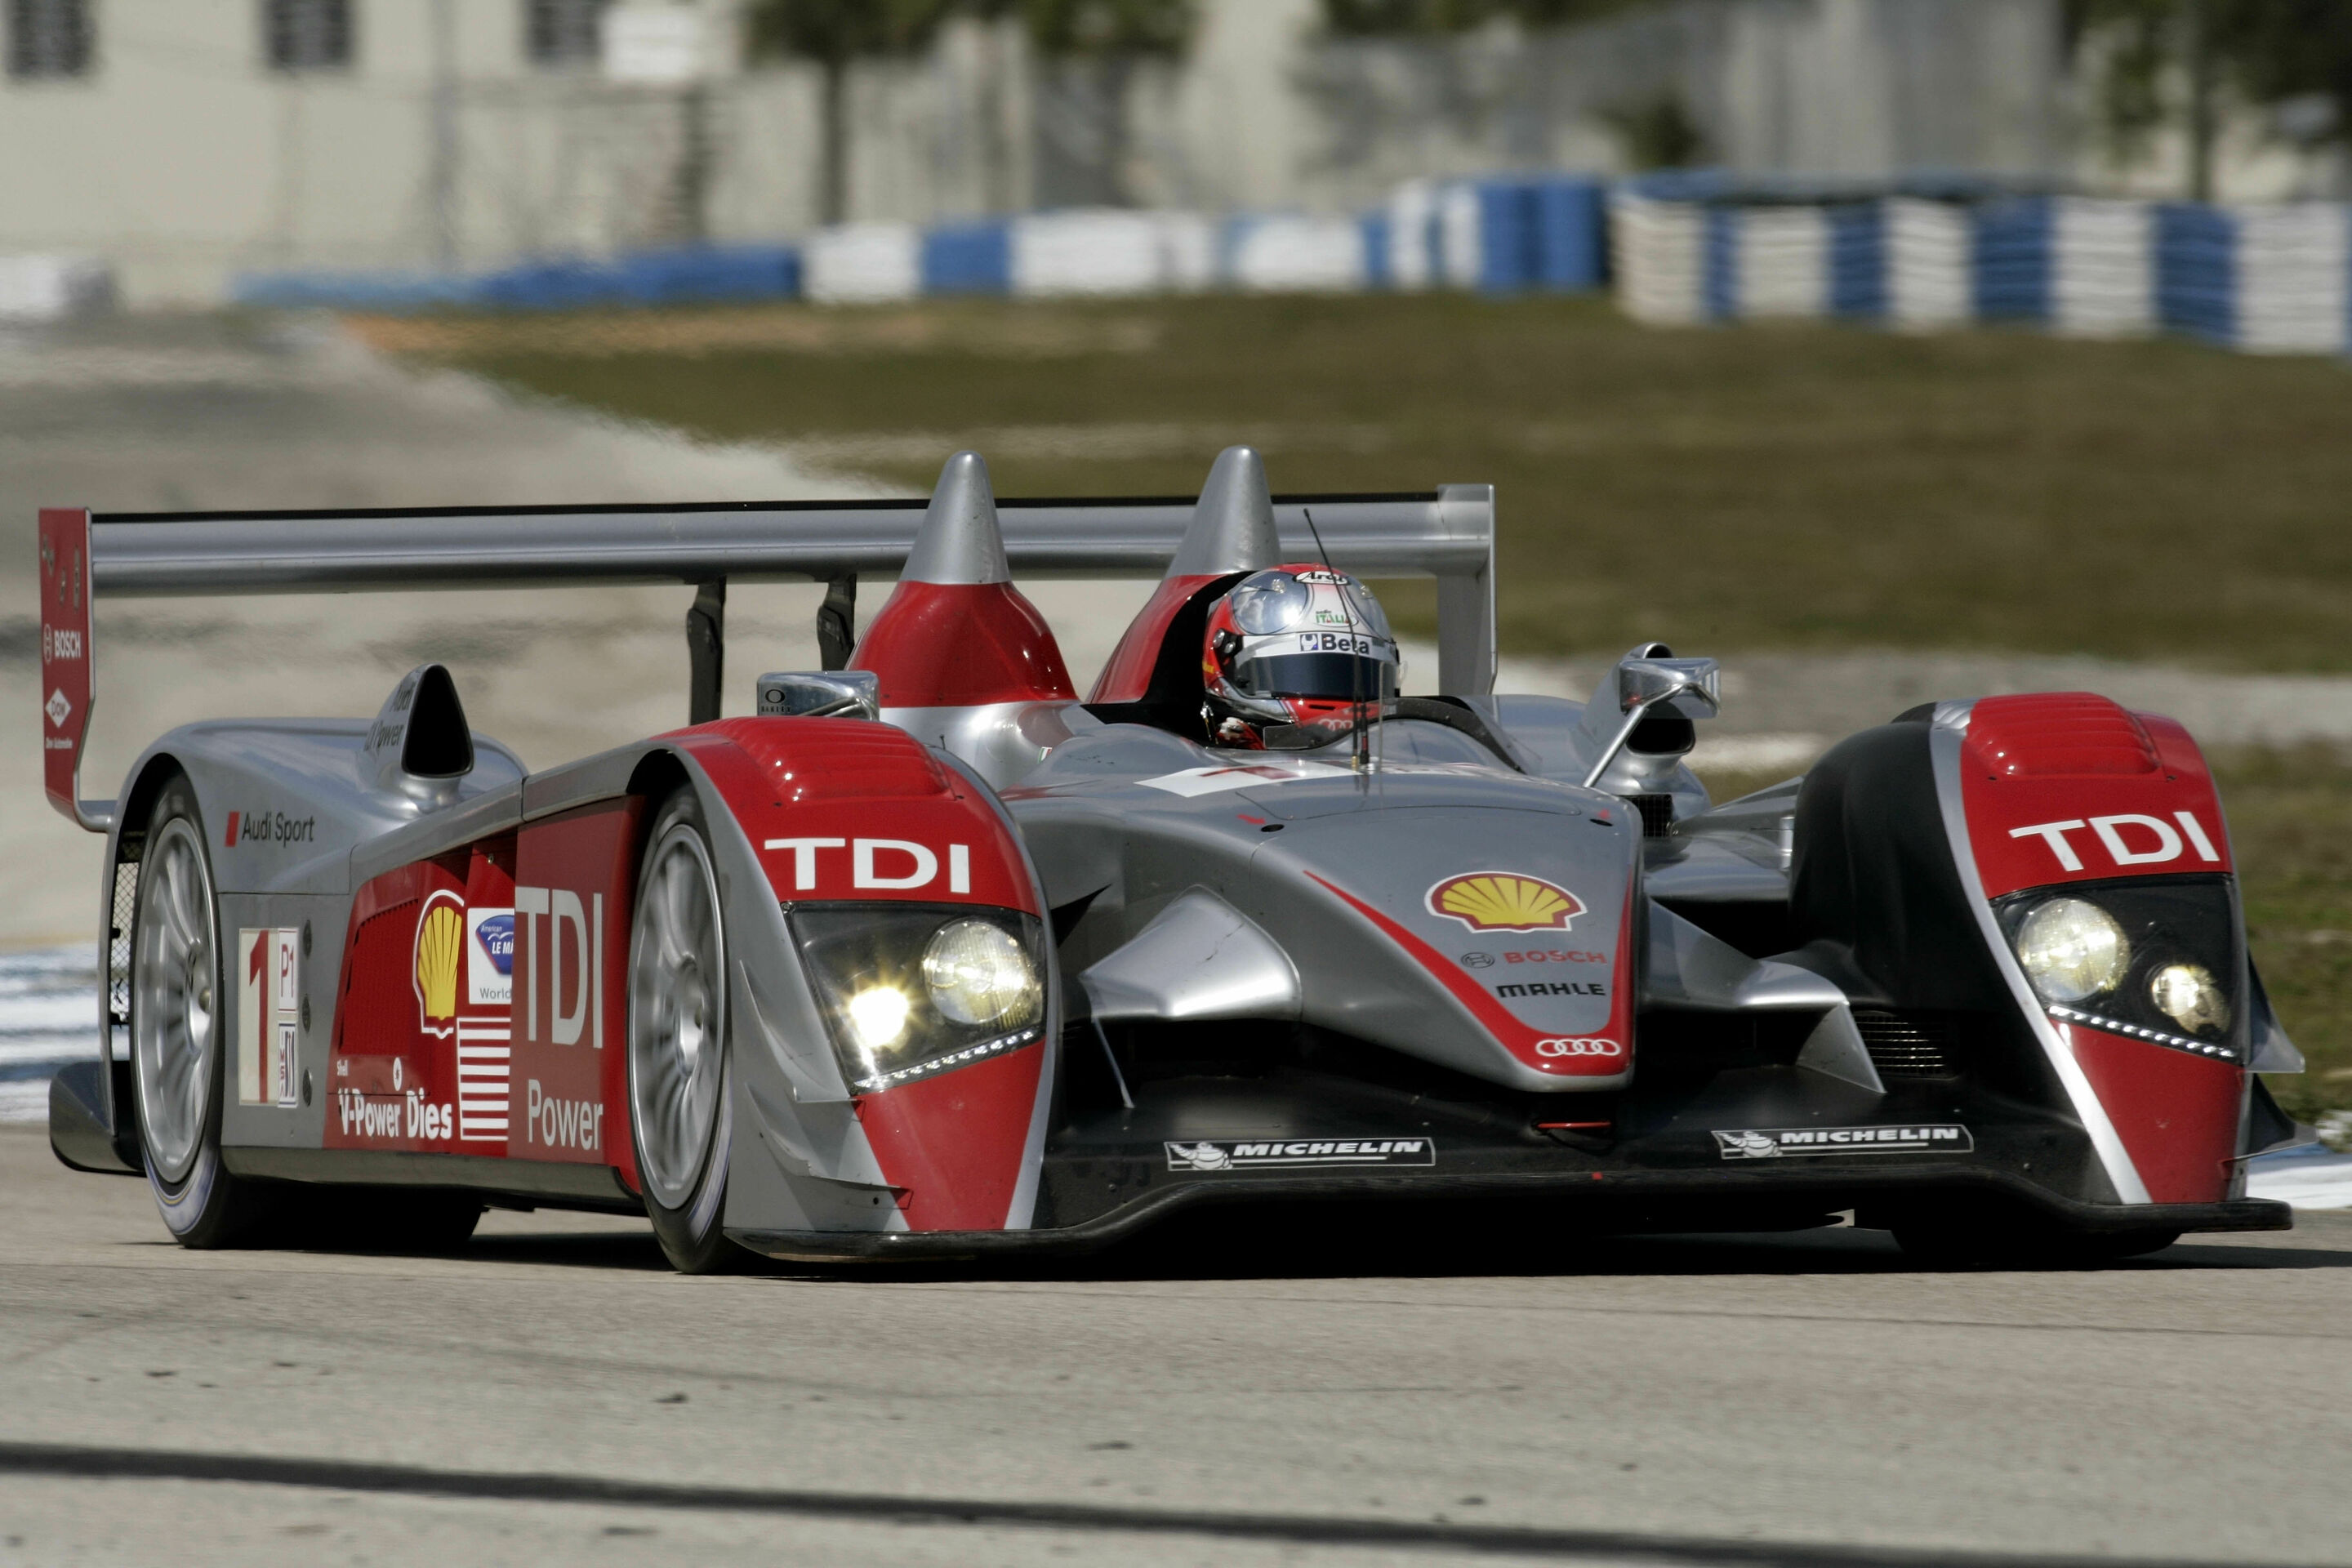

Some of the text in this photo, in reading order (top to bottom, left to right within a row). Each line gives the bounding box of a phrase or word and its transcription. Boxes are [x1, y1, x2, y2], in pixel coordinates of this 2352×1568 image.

[54, 630, 81, 658] BOSCH
[1321, 633, 1370, 654] Beta
[242, 811, 314, 849] Audi Sport
[2007, 811, 2221, 872] TDI
[764, 837, 970, 894] TDI
[492, 942, 502, 954] LE
[514, 885, 604, 1049] TDI
[1503, 950, 1607, 964] BOSCH
[282, 944, 294, 998] P1
[1496, 982, 1606, 998] MAHLE
[250, 929, 269, 1103] 1
[338, 1088, 400, 1138] V-Power
[528, 1079, 604, 1151] Power
[1232, 1142, 1423, 1156] MICHELIN
[1780, 1129, 1958, 1143] MICHELIN
